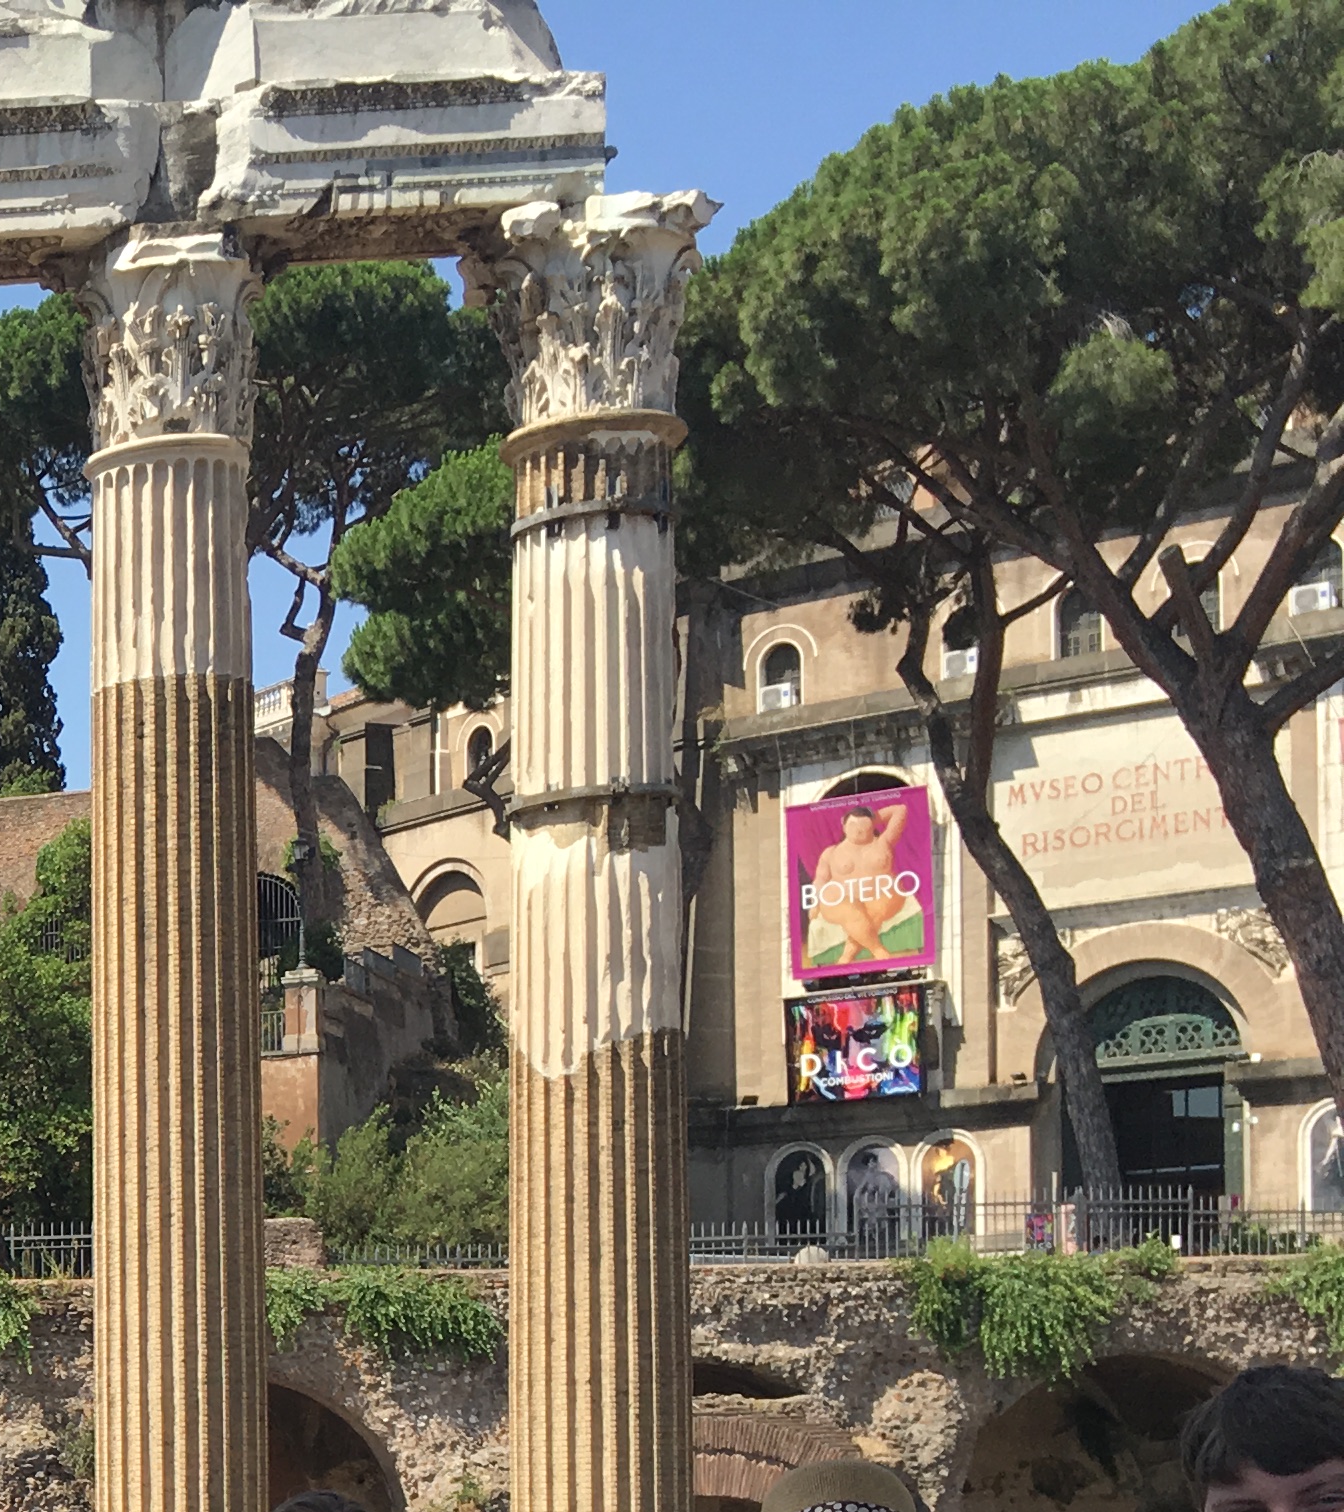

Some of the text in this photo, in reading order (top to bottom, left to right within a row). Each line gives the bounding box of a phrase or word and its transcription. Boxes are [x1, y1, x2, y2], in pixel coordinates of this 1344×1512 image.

[1007, 772, 1103, 807] MVSEO
[1112, 790, 1166, 816] DEL
[801, 870, 920, 910] BOTERO
[800, 1037, 913, 1077] DICÒ
[820, 1072, 894, 1088] COMBUSTIONI
